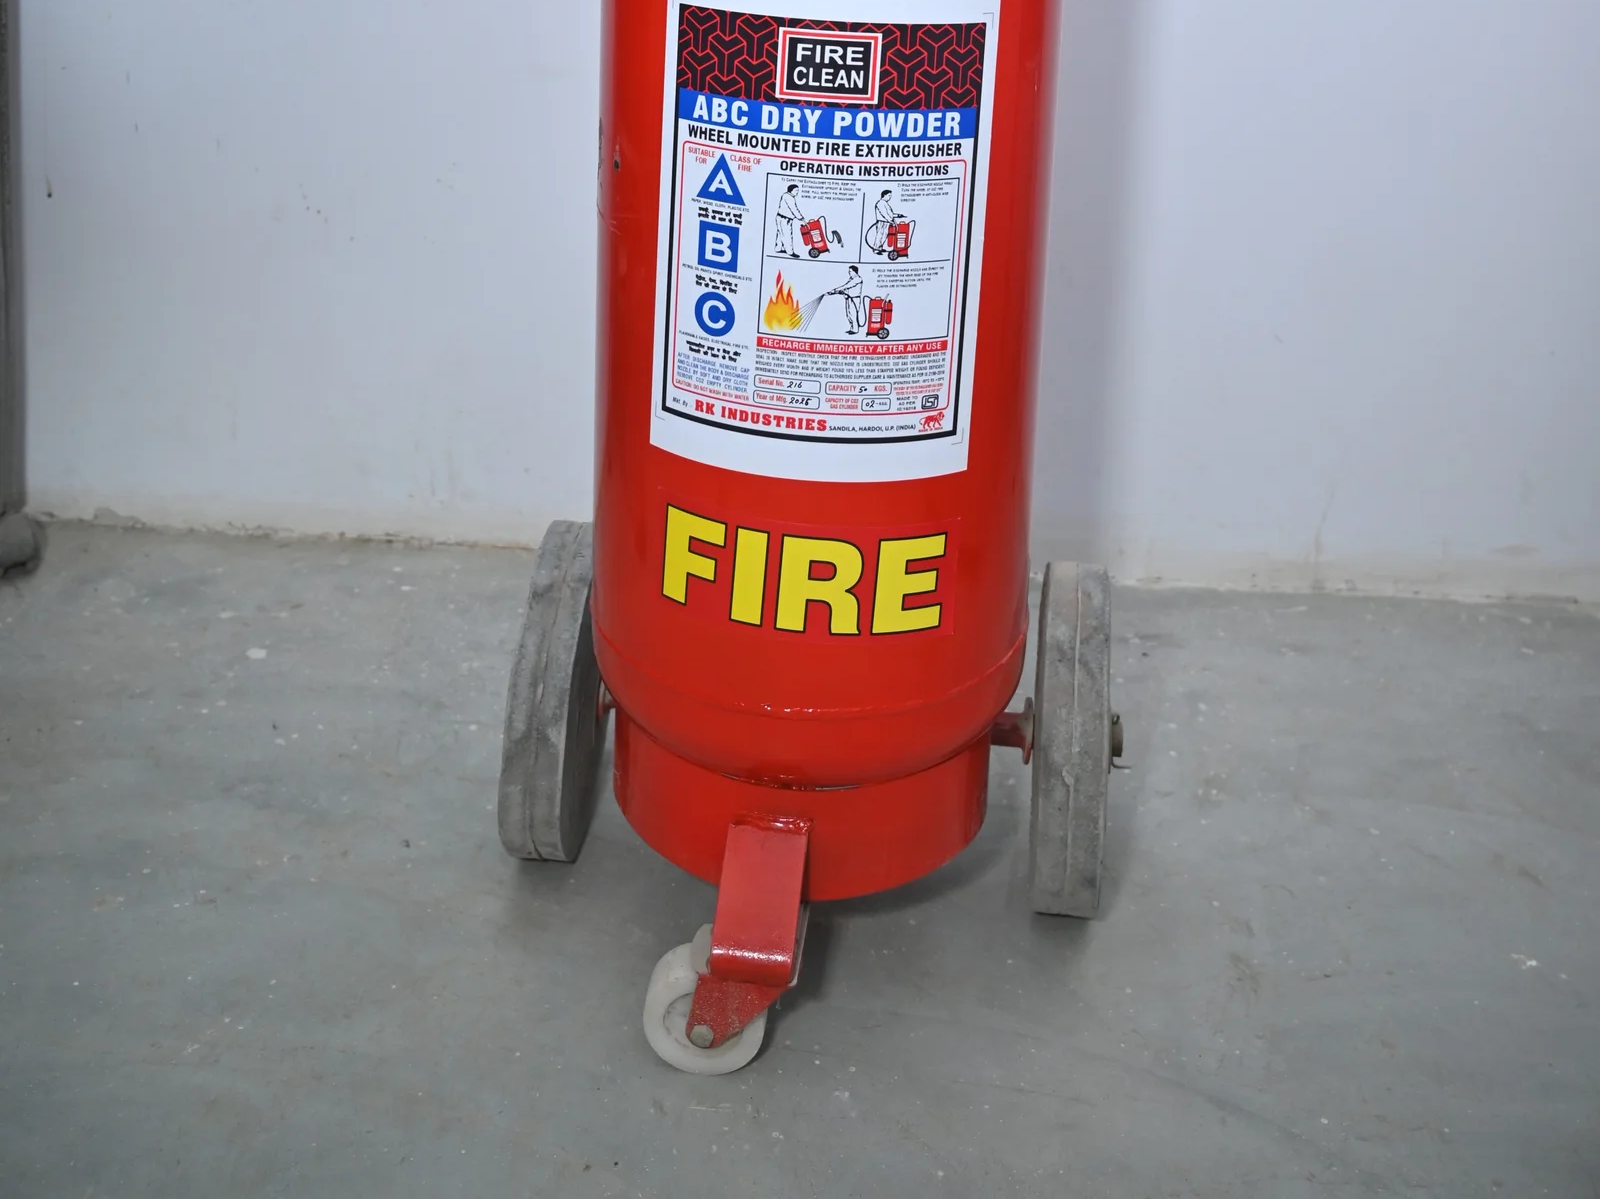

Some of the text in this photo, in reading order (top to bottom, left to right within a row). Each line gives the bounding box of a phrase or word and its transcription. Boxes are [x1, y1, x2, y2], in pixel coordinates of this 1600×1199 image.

[796, 43, 865, 66] FIRE
[793, 66, 865, 89] CLEAN
[692, 95, 961, 138] ABC DRY POWDER
[688, 124, 962, 158] WHEEL MOUNTED FIRE EXTINGUISHER
[688, 147, 716, 158] SUITABLE
[730, 154, 751, 164] CLASS
[738, 164, 752, 172] FIRE
[780, 160, 949, 176] OPERATING INSTRUCTIONS
[708, 169, 734, 196] A
[704, 229, 732, 263] B
[702, 299, 727, 329] C
[762, 338, 942, 353] RECHARGE IMMEDIATELY AFTER ANY USE
[758, 377, 774, 385] Serial
[695, 399, 715, 415] RK
[721, 405, 827, 431] INDUSTRIES
[661, 502, 948, 636] FIRE
